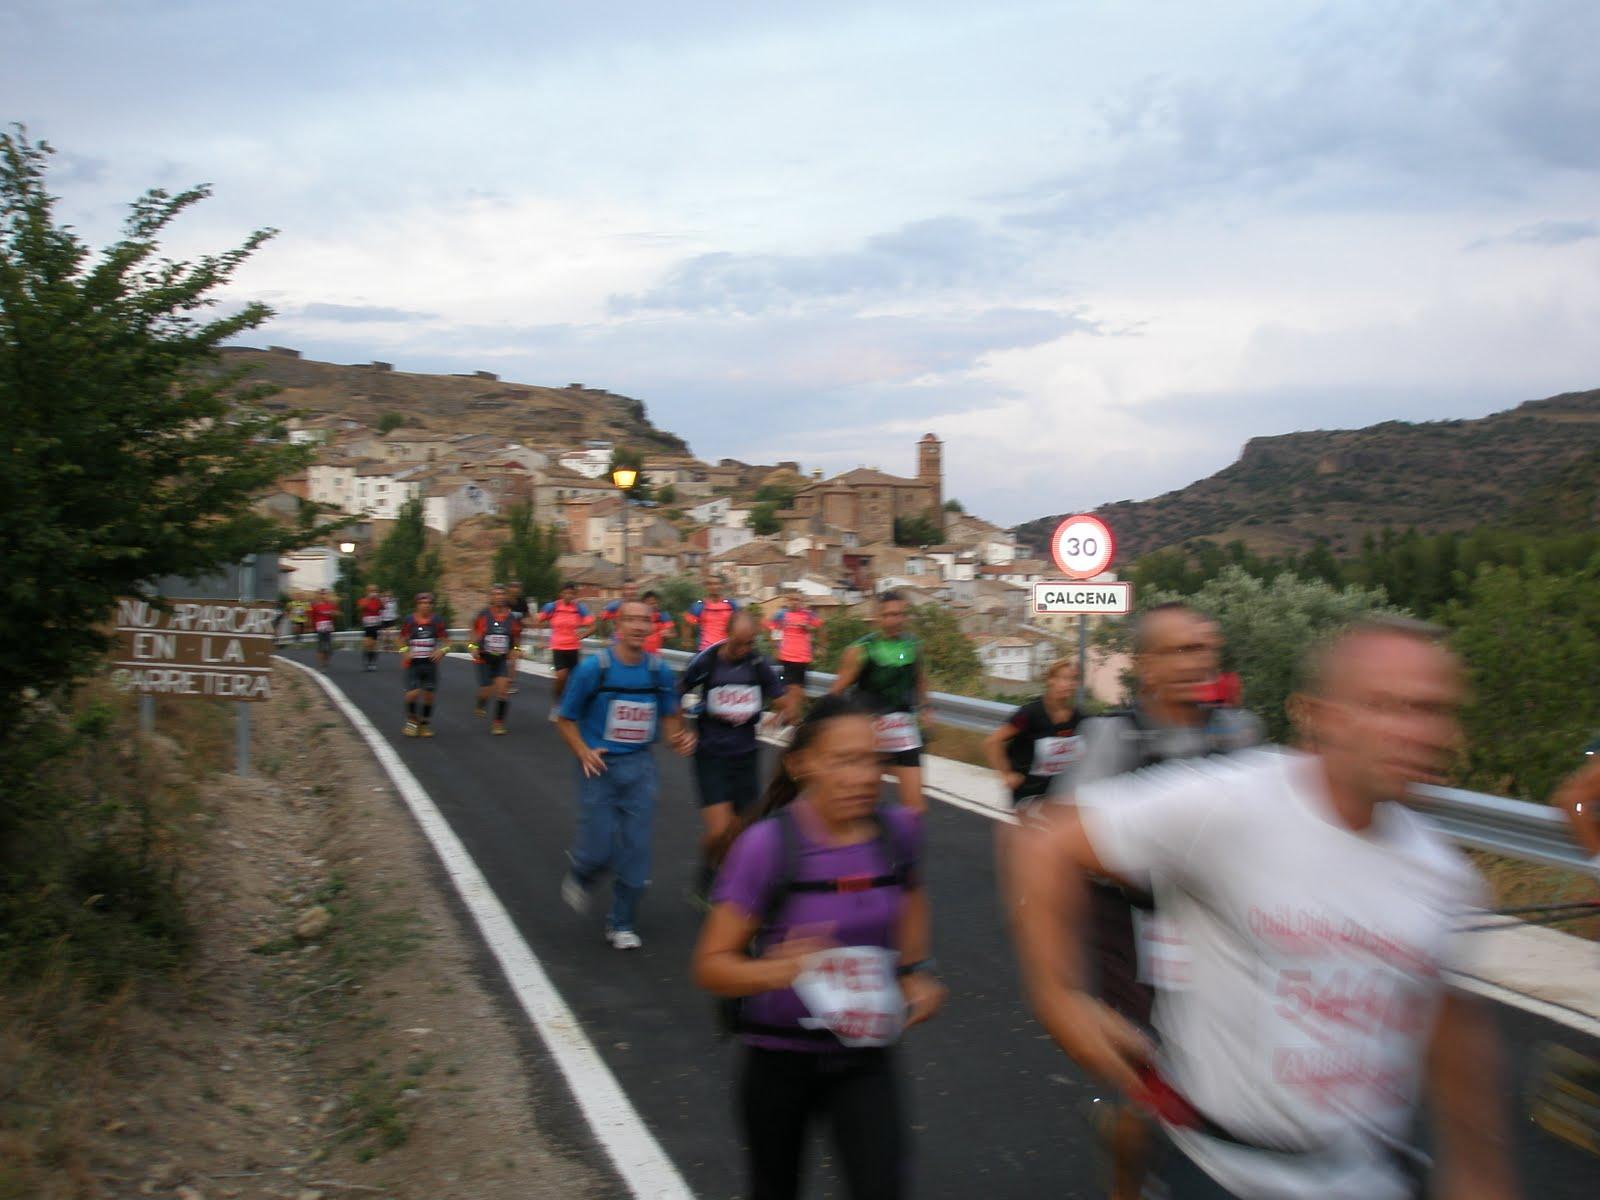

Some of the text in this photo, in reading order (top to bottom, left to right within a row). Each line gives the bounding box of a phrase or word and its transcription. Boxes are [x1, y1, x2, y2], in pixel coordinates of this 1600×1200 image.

[1067, 537, 1097, 556] 30
[1044, 591, 1117, 605] CALCENA
[133, 633, 246, 663] EN LA
[112, 669, 272, 698] CARRETERA
